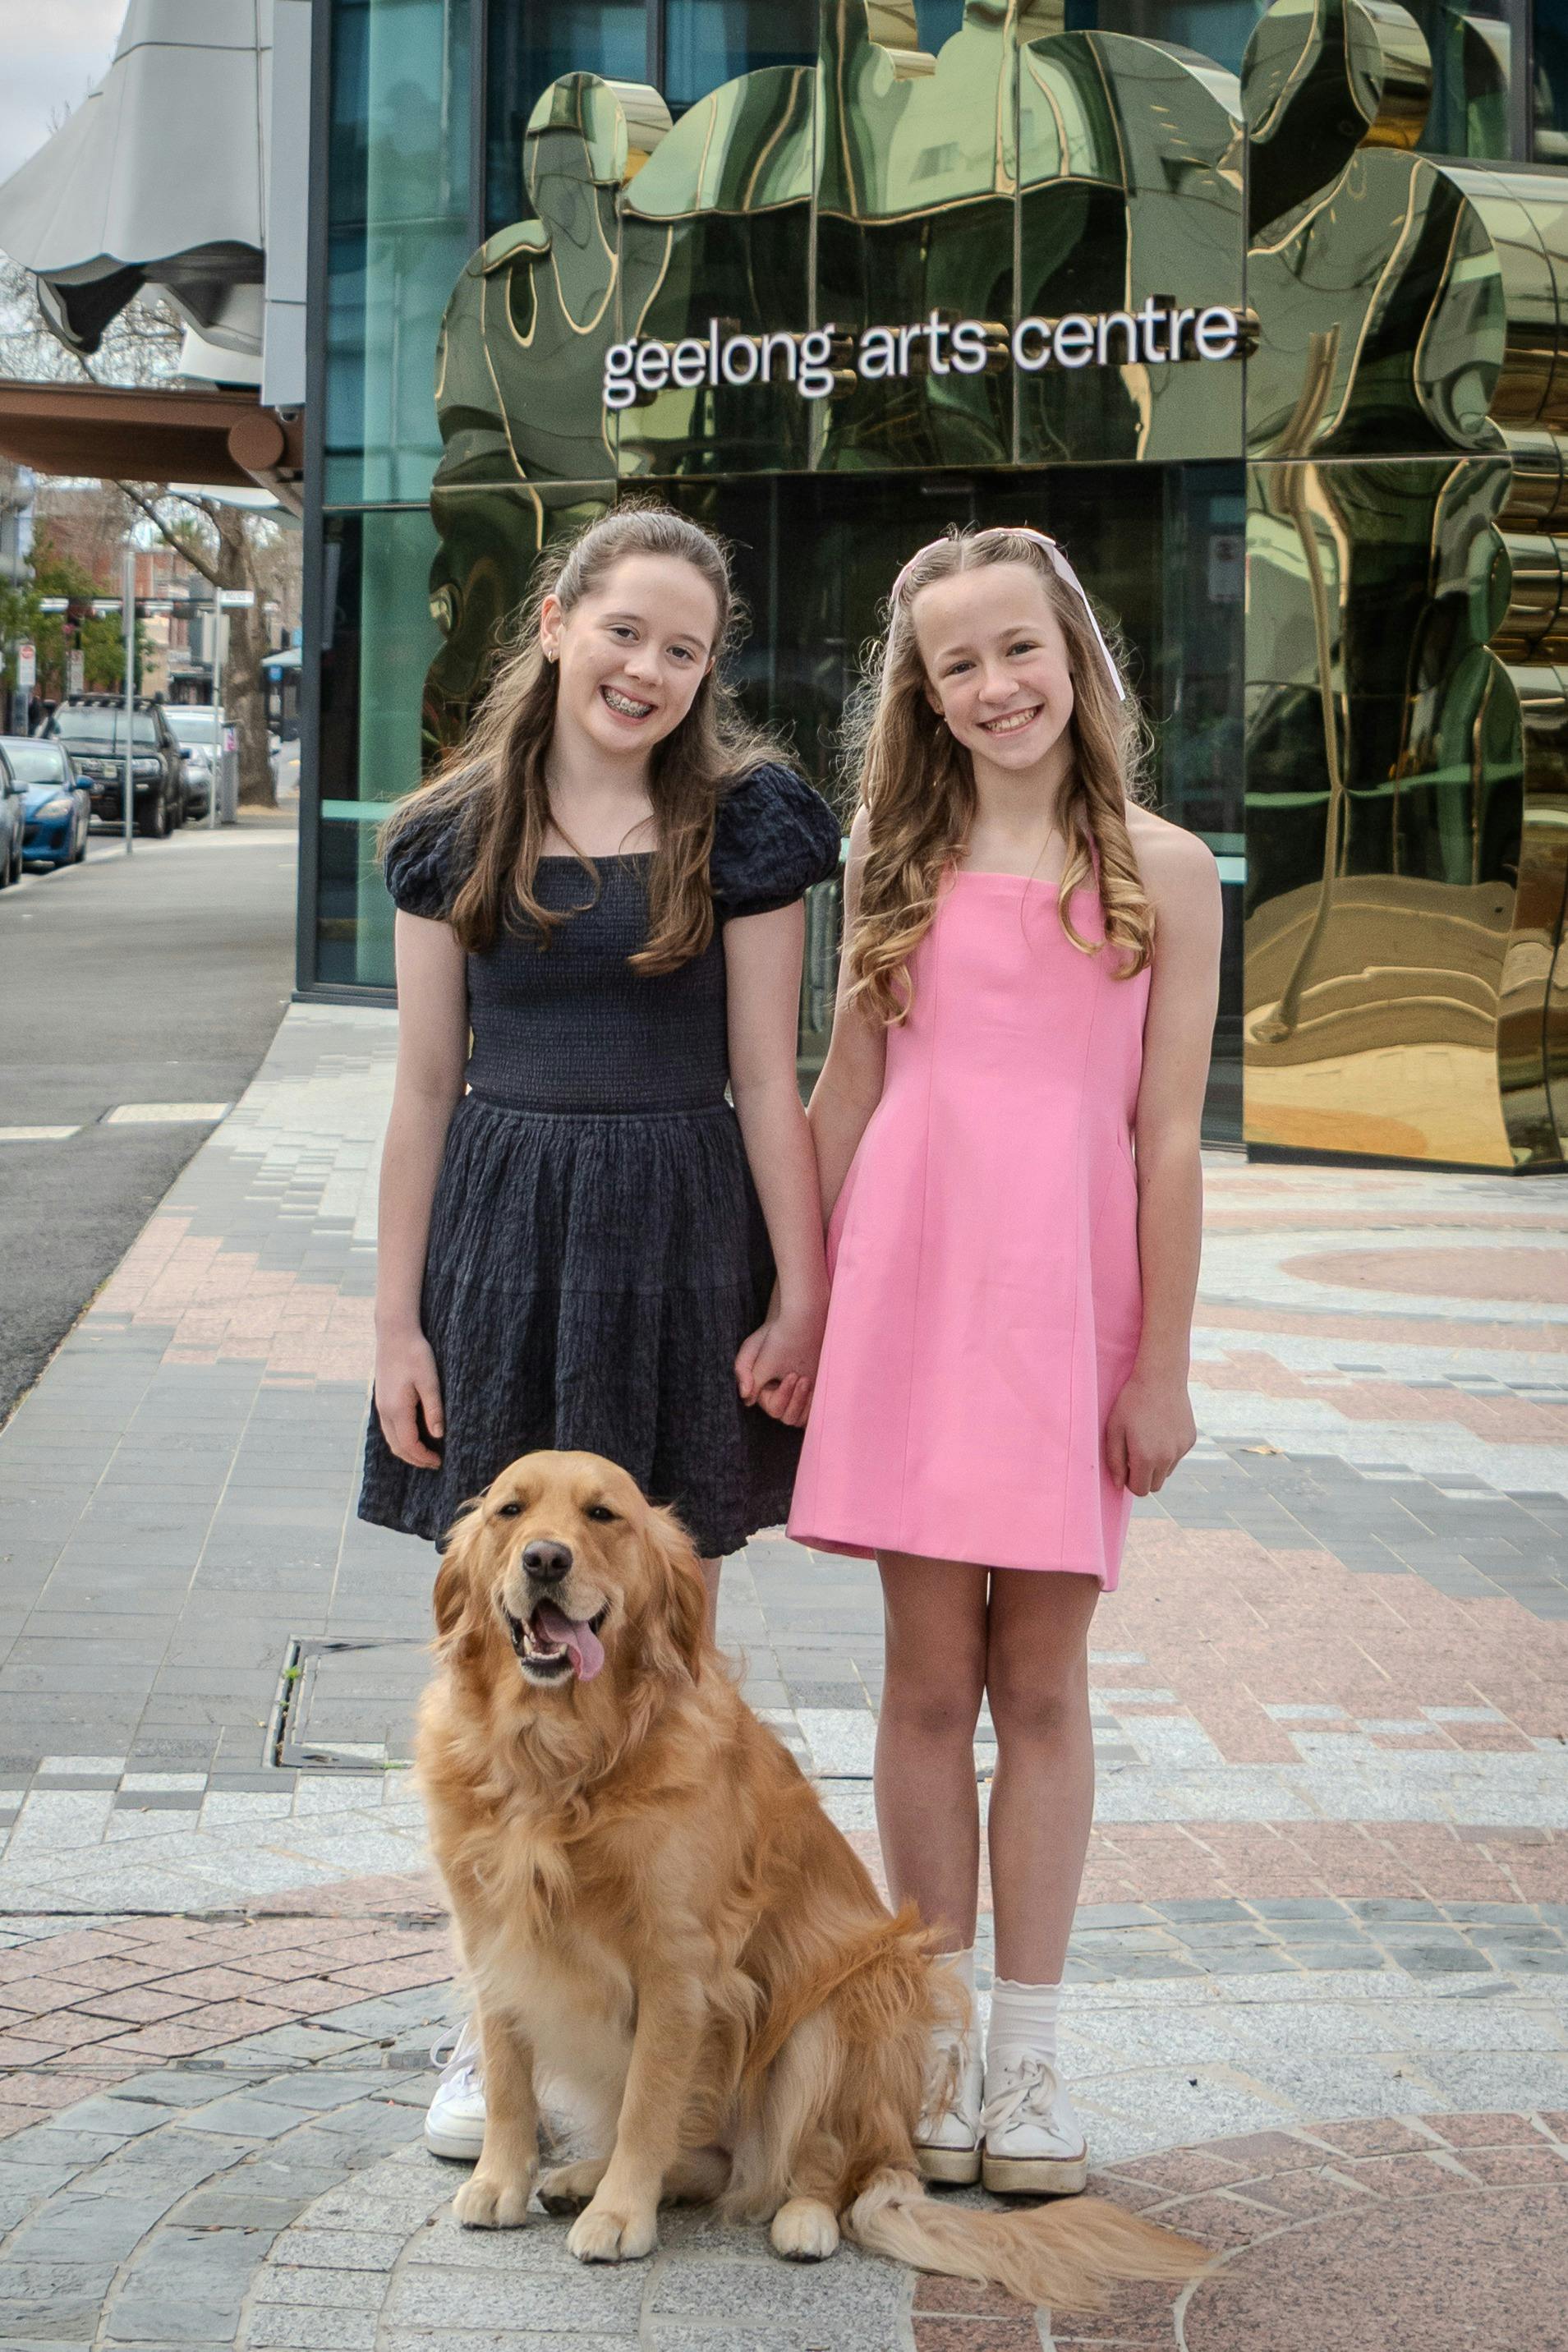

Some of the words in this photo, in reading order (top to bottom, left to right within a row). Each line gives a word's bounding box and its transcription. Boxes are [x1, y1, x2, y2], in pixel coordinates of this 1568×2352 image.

[603, 318, 835, 408] geelong
[858, 307, 986, 379] arts
[1012, 296, 1238, 370] centre
